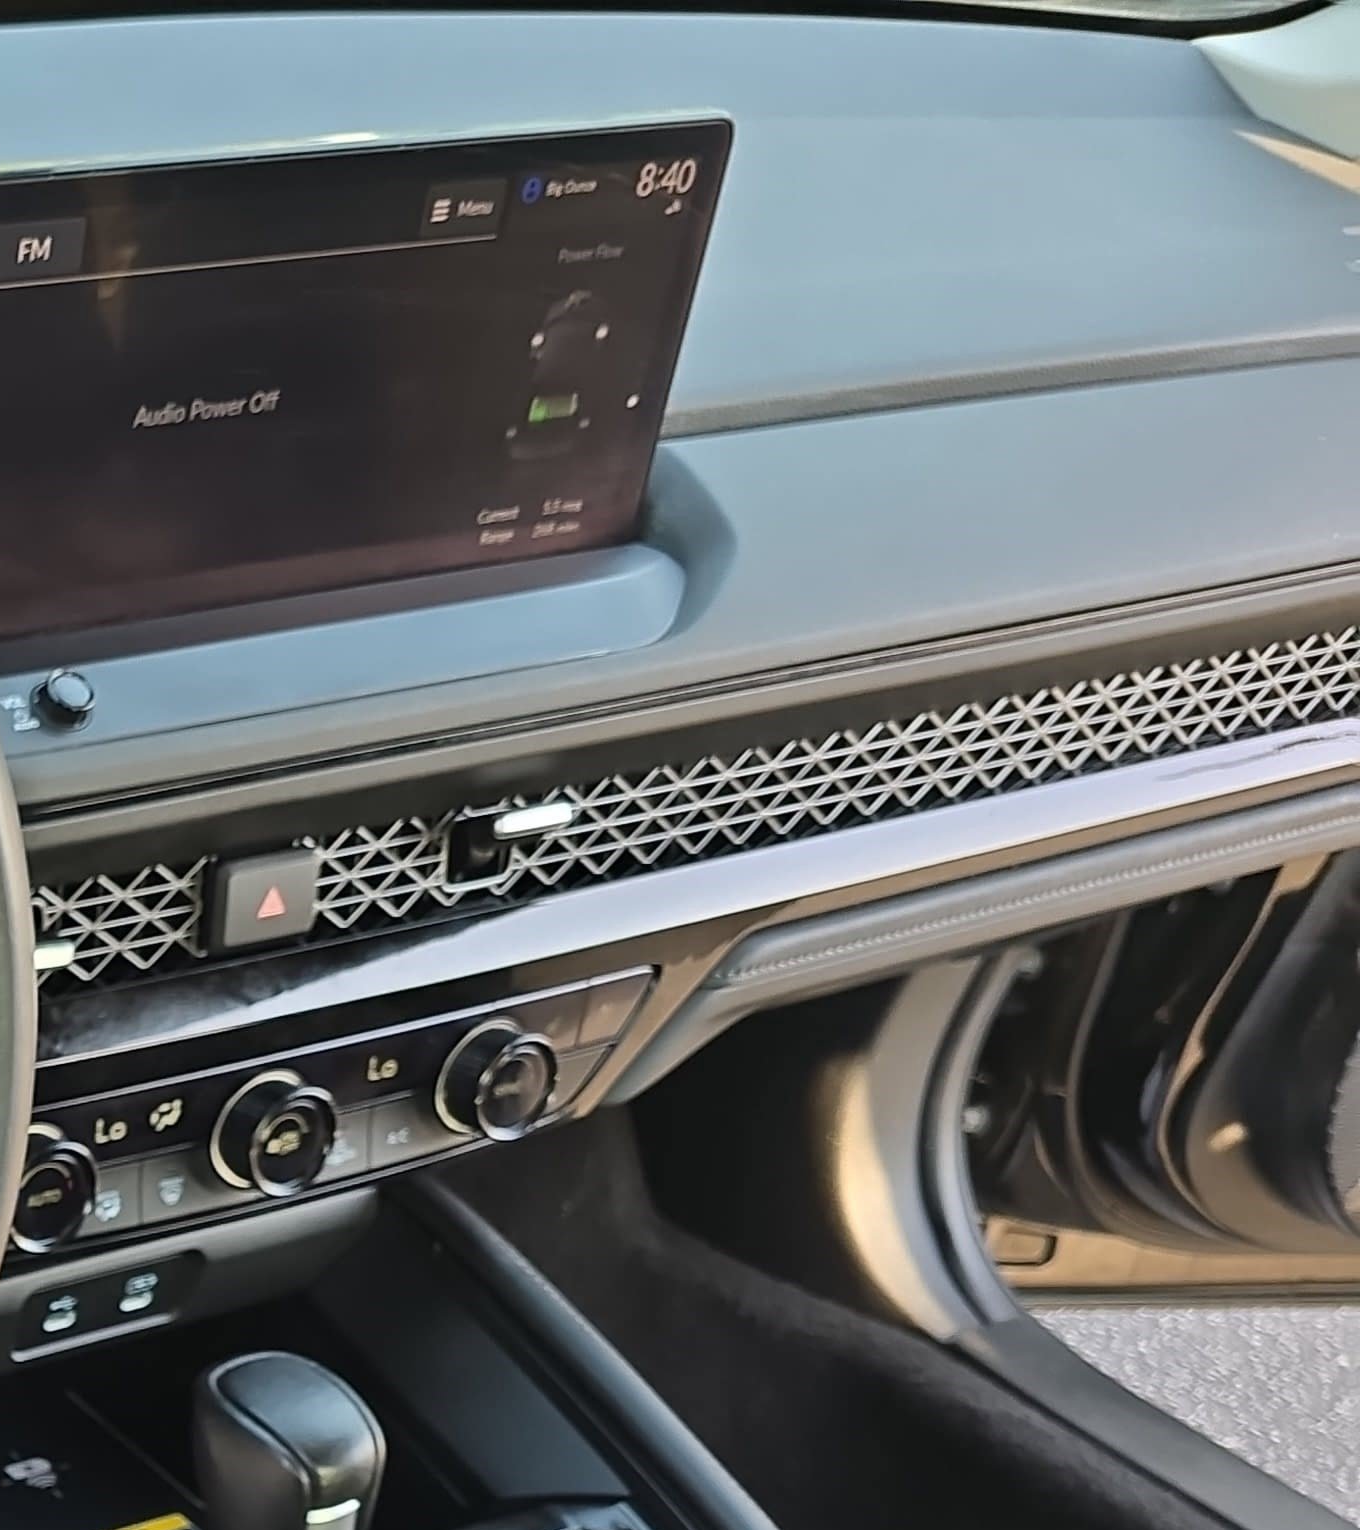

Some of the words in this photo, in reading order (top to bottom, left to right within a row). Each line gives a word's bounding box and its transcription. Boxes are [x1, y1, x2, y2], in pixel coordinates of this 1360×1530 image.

[636, 159, 696, 197] 8:40
[458, 201, 494, 217] Menu
[17, 236, 53, 264] FM
[133, 403, 185, 429] Audio
[189, 398, 246, 421] Power
[249, 390, 280, 414] Off
